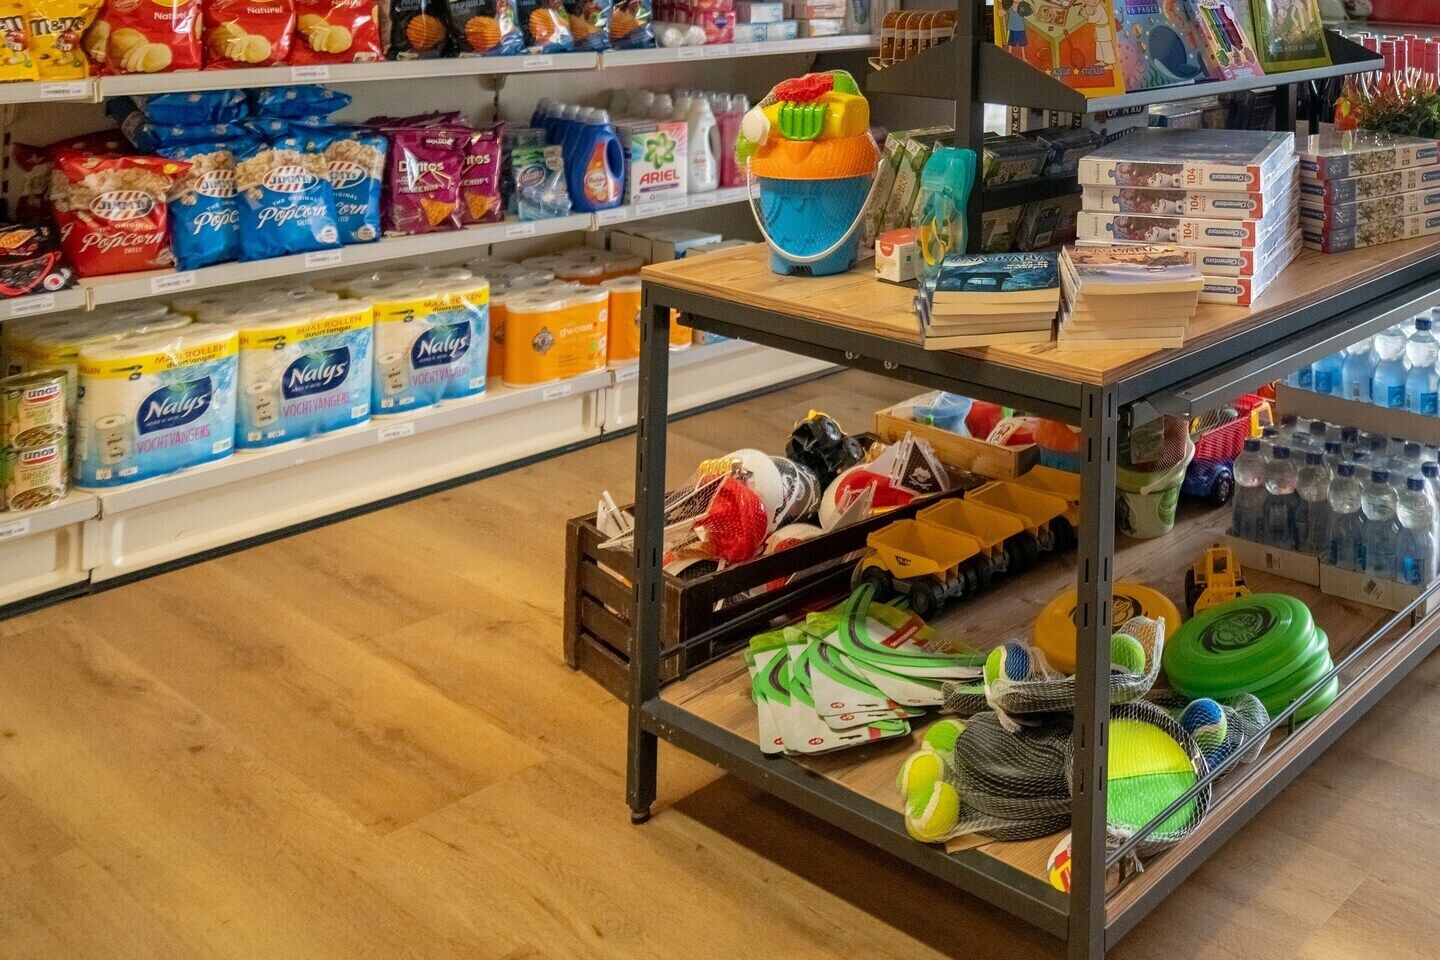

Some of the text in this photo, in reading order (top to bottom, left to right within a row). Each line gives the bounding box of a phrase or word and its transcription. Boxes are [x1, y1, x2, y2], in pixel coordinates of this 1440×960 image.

[247, 5, 283, 15] Naturel
[398, 160, 445, 173] Dritos
[464, 154, 491, 166] ritos
[639, 169, 681, 186] ARIEL
[1187, 167, 1196, 185] 104
[1211, 174, 1245, 182] Clementoni
[206, 200, 238, 211] THE ORIG
[272, 198, 286, 207] THE
[1189, 194, 1199, 212] 104
[1214, 199, 1247, 209] Clementoni
[193, 209, 239, 236] Popc
[1183, 222, 1193, 240] 104
[1207, 227, 1240, 237] Clementoni
[1205, 256, 1238, 266] Clementoni
[449, 293, 482, 305] ROLEN
[324, 315, 362, 328] ROLLEN
[327, 324, 352, 335] langer
[559, 322, 594, 339] gwoon
[185, 344, 227, 357] ROLLEN
[416, 334, 469, 359] Nalys
[192, 353, 217, 364] langer
[288, 363, 347, 389] Nalys
[28, 384, 59, 399] unox
[143, 393, 208, 422] Nalys
[282, 391, 350, 418] VOCHTVANGERS
[137, 424, 211, 455] VOCHTVANGERS
[23, 446, 55, 460] unox
